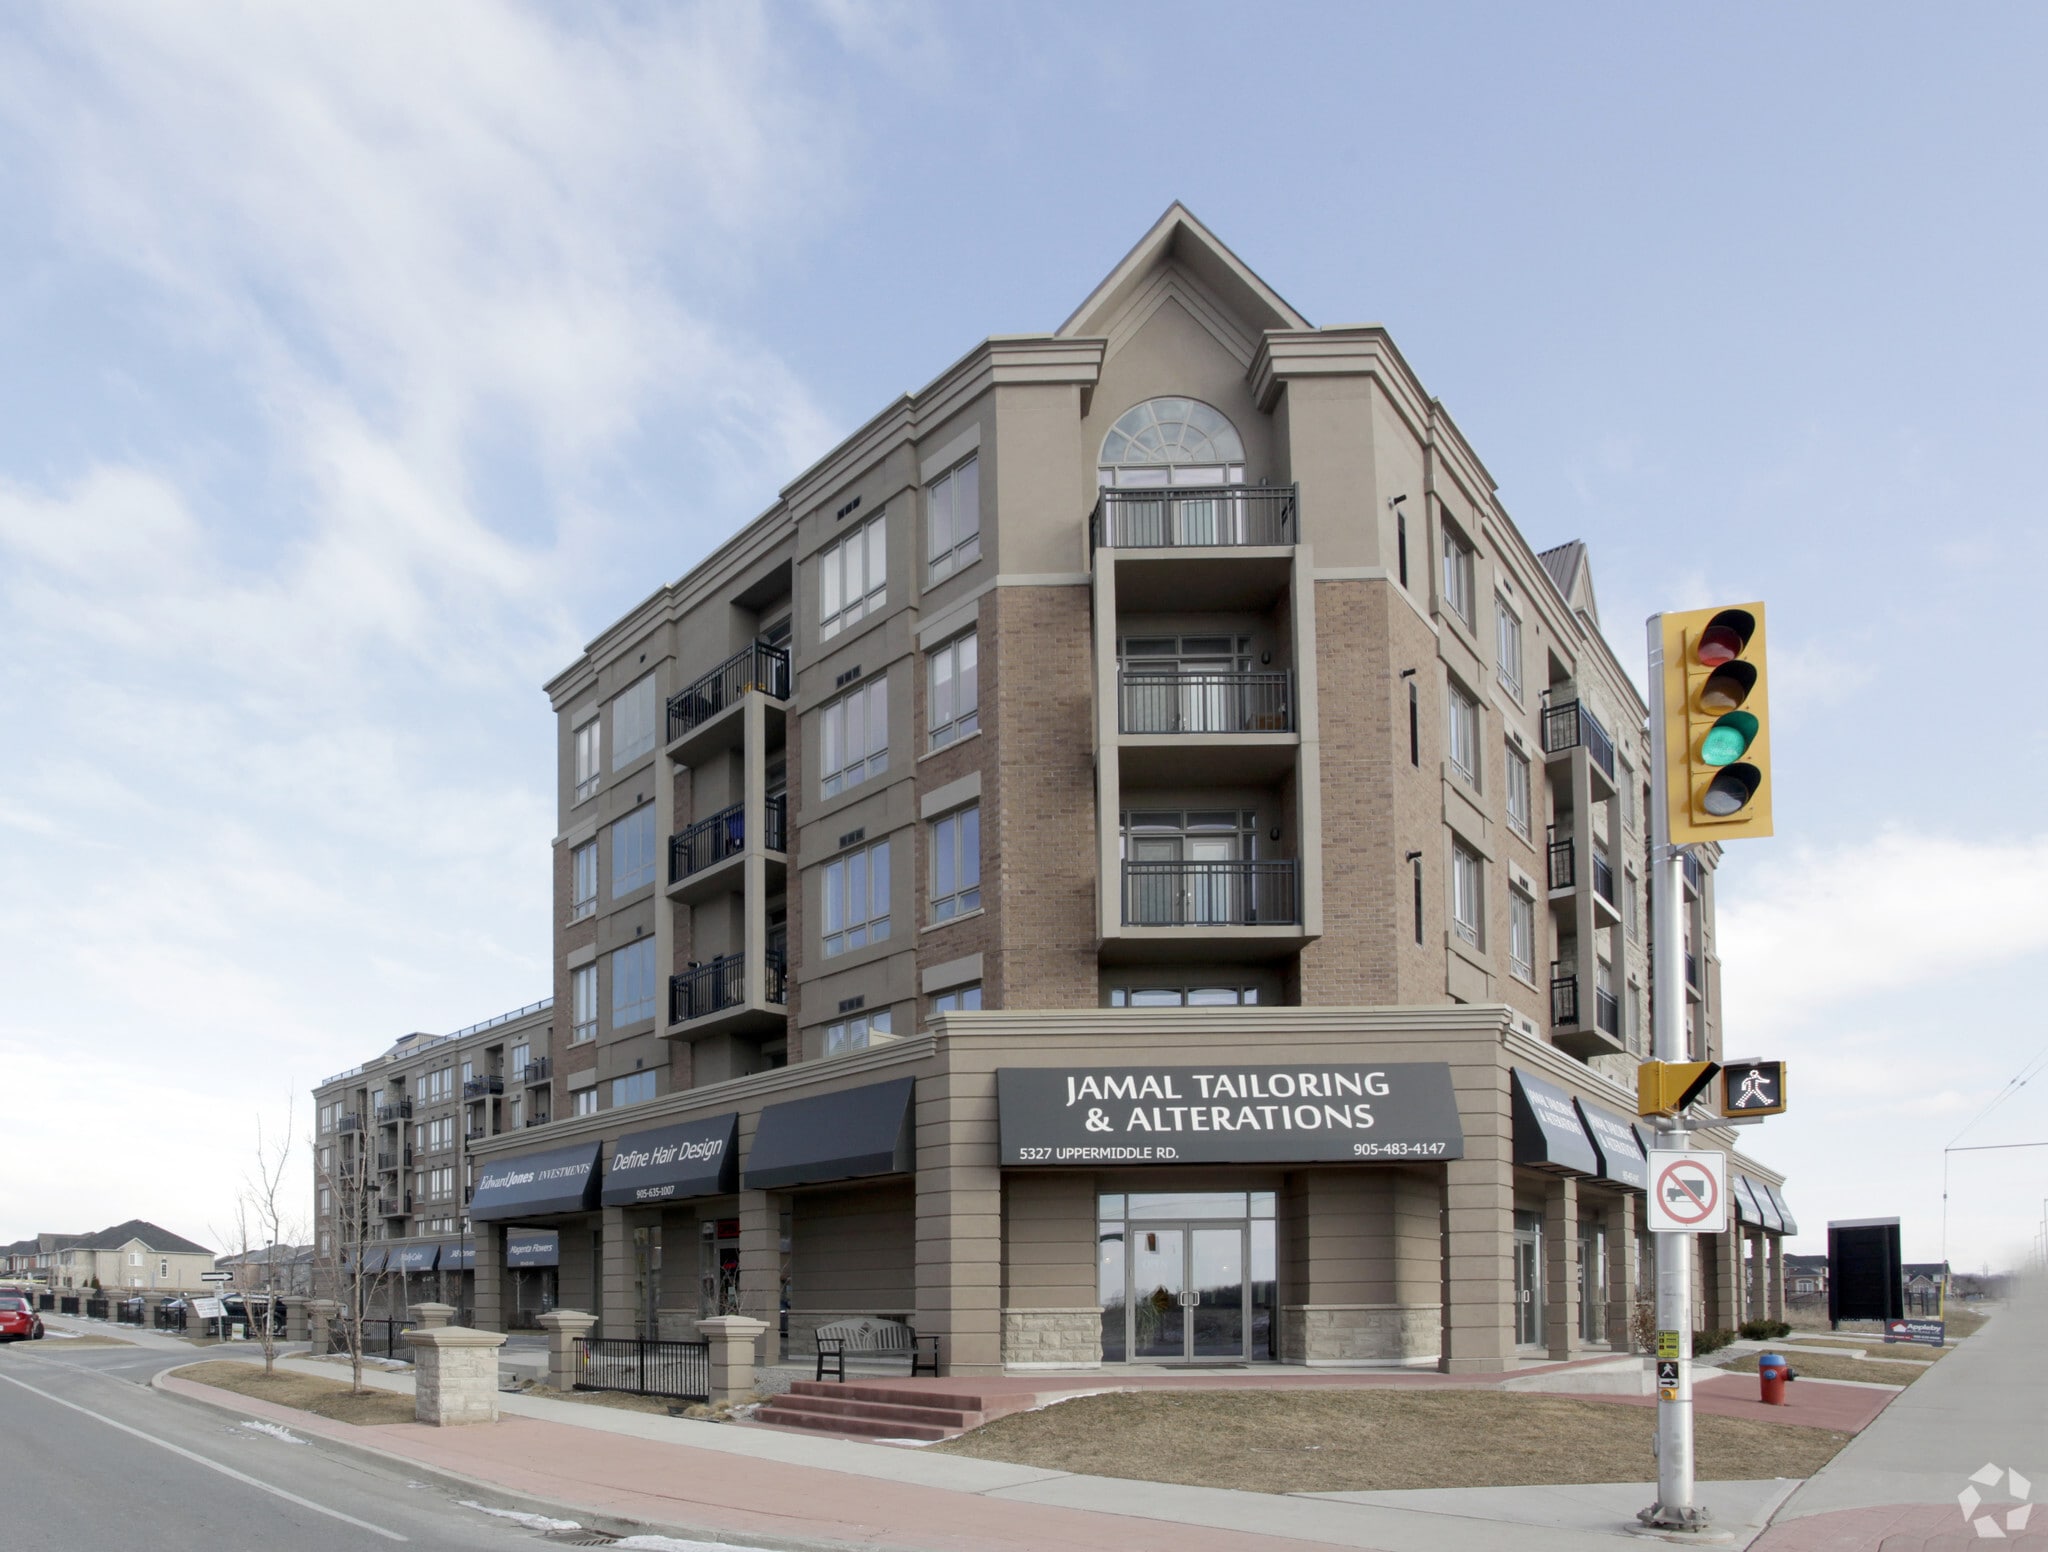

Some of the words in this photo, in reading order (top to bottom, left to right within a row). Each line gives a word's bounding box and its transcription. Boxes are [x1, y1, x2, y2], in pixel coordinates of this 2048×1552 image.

[1066, 1076, 1182, 1106] JAMAL
[1193, 1071, 1391, 1099] TAILORING
[1085, 1107, 1114, 1133] &
[1126, 1104, 1375, 1132] ALTERATIONS
[612, 1150, 650, 1172] Define
[650, 1144, 678, 1165] Hair
[678, 1137, 723, 1162] Design
[1019, 1147, 1052, 1160] 5327
[1055, 1146, 1153, 1160] UPPERMIDDLE
[1156, 1146, 1180, 1159] RD.
[1353, 1142, 1446, 1156] 905-483-4147
[538, 1162, 592, 1181] INVESTMENTS
[635, 1185, 675, 1199] 905-635-1007
[532, 1243, 553, 1253] Flowers
[1907, 1323, 1942, 1333] Appleby
